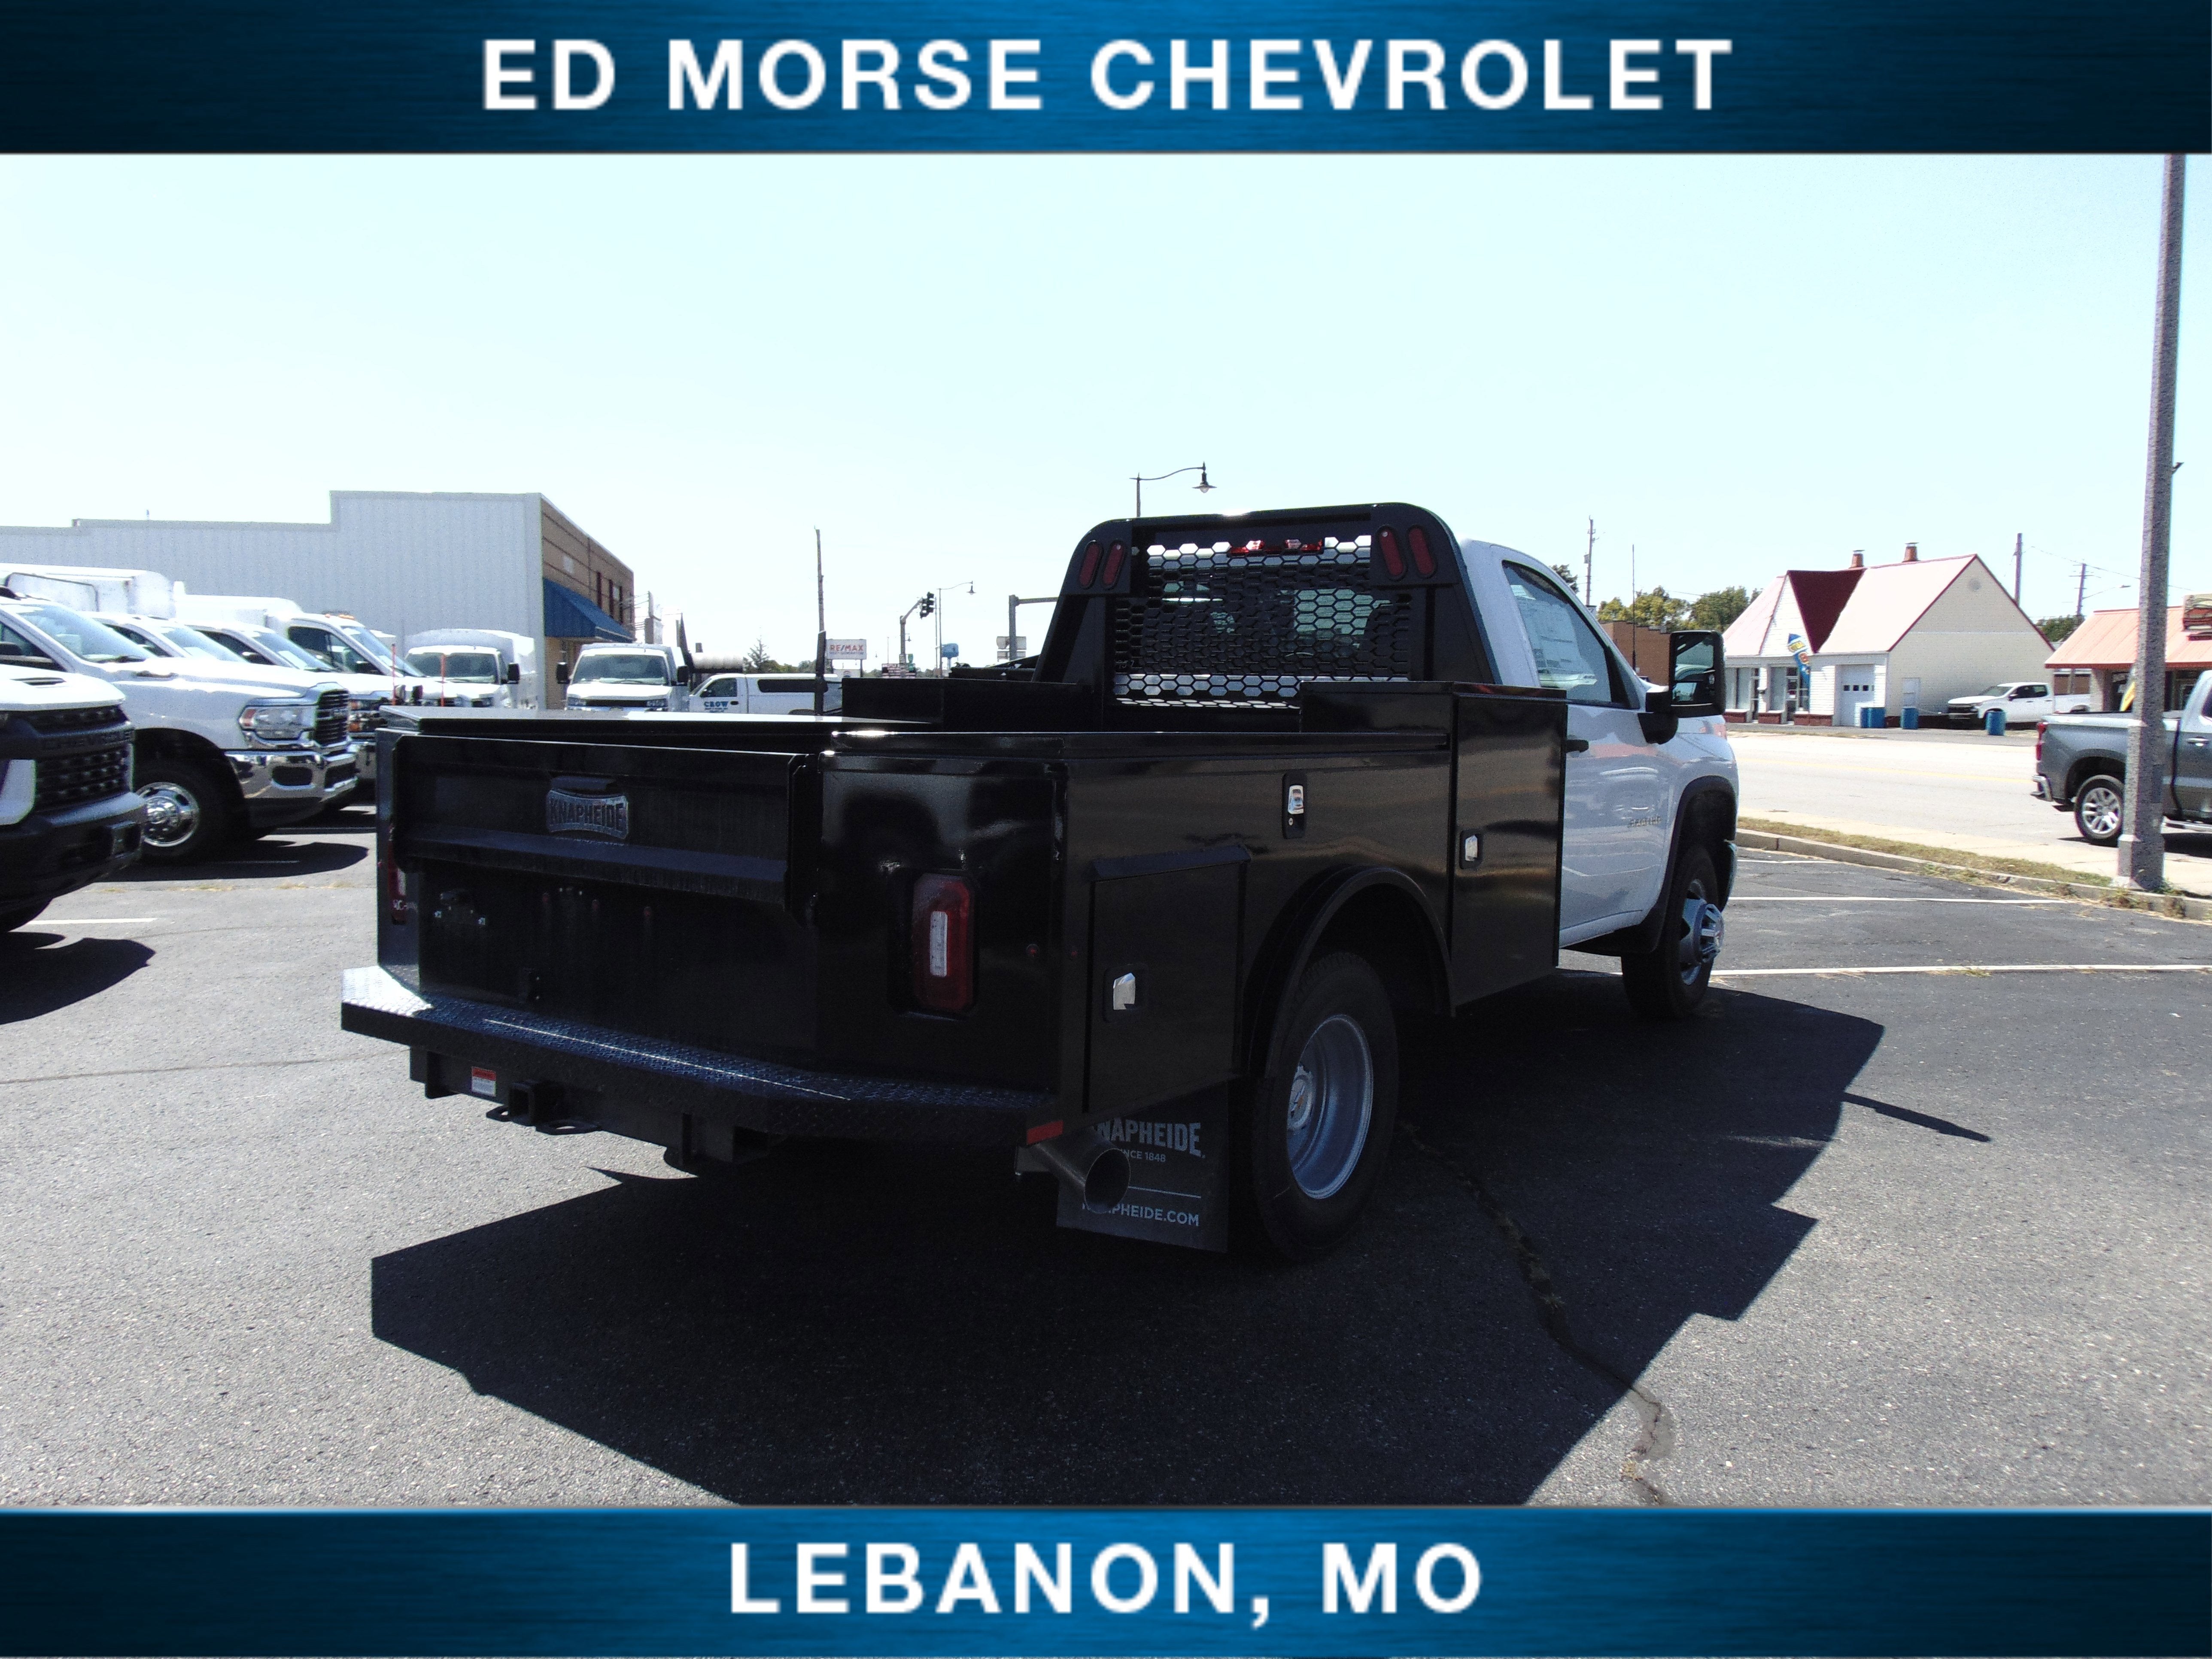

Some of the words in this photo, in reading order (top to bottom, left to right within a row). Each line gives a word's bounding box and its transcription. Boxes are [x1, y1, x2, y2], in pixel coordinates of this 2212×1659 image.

[549, 797, 626, 832] KNAPHEIDE
[1096, 1117, 1202, 1158] NAPHEIDE
[1145, 1151, 1166, 1163] 1848
